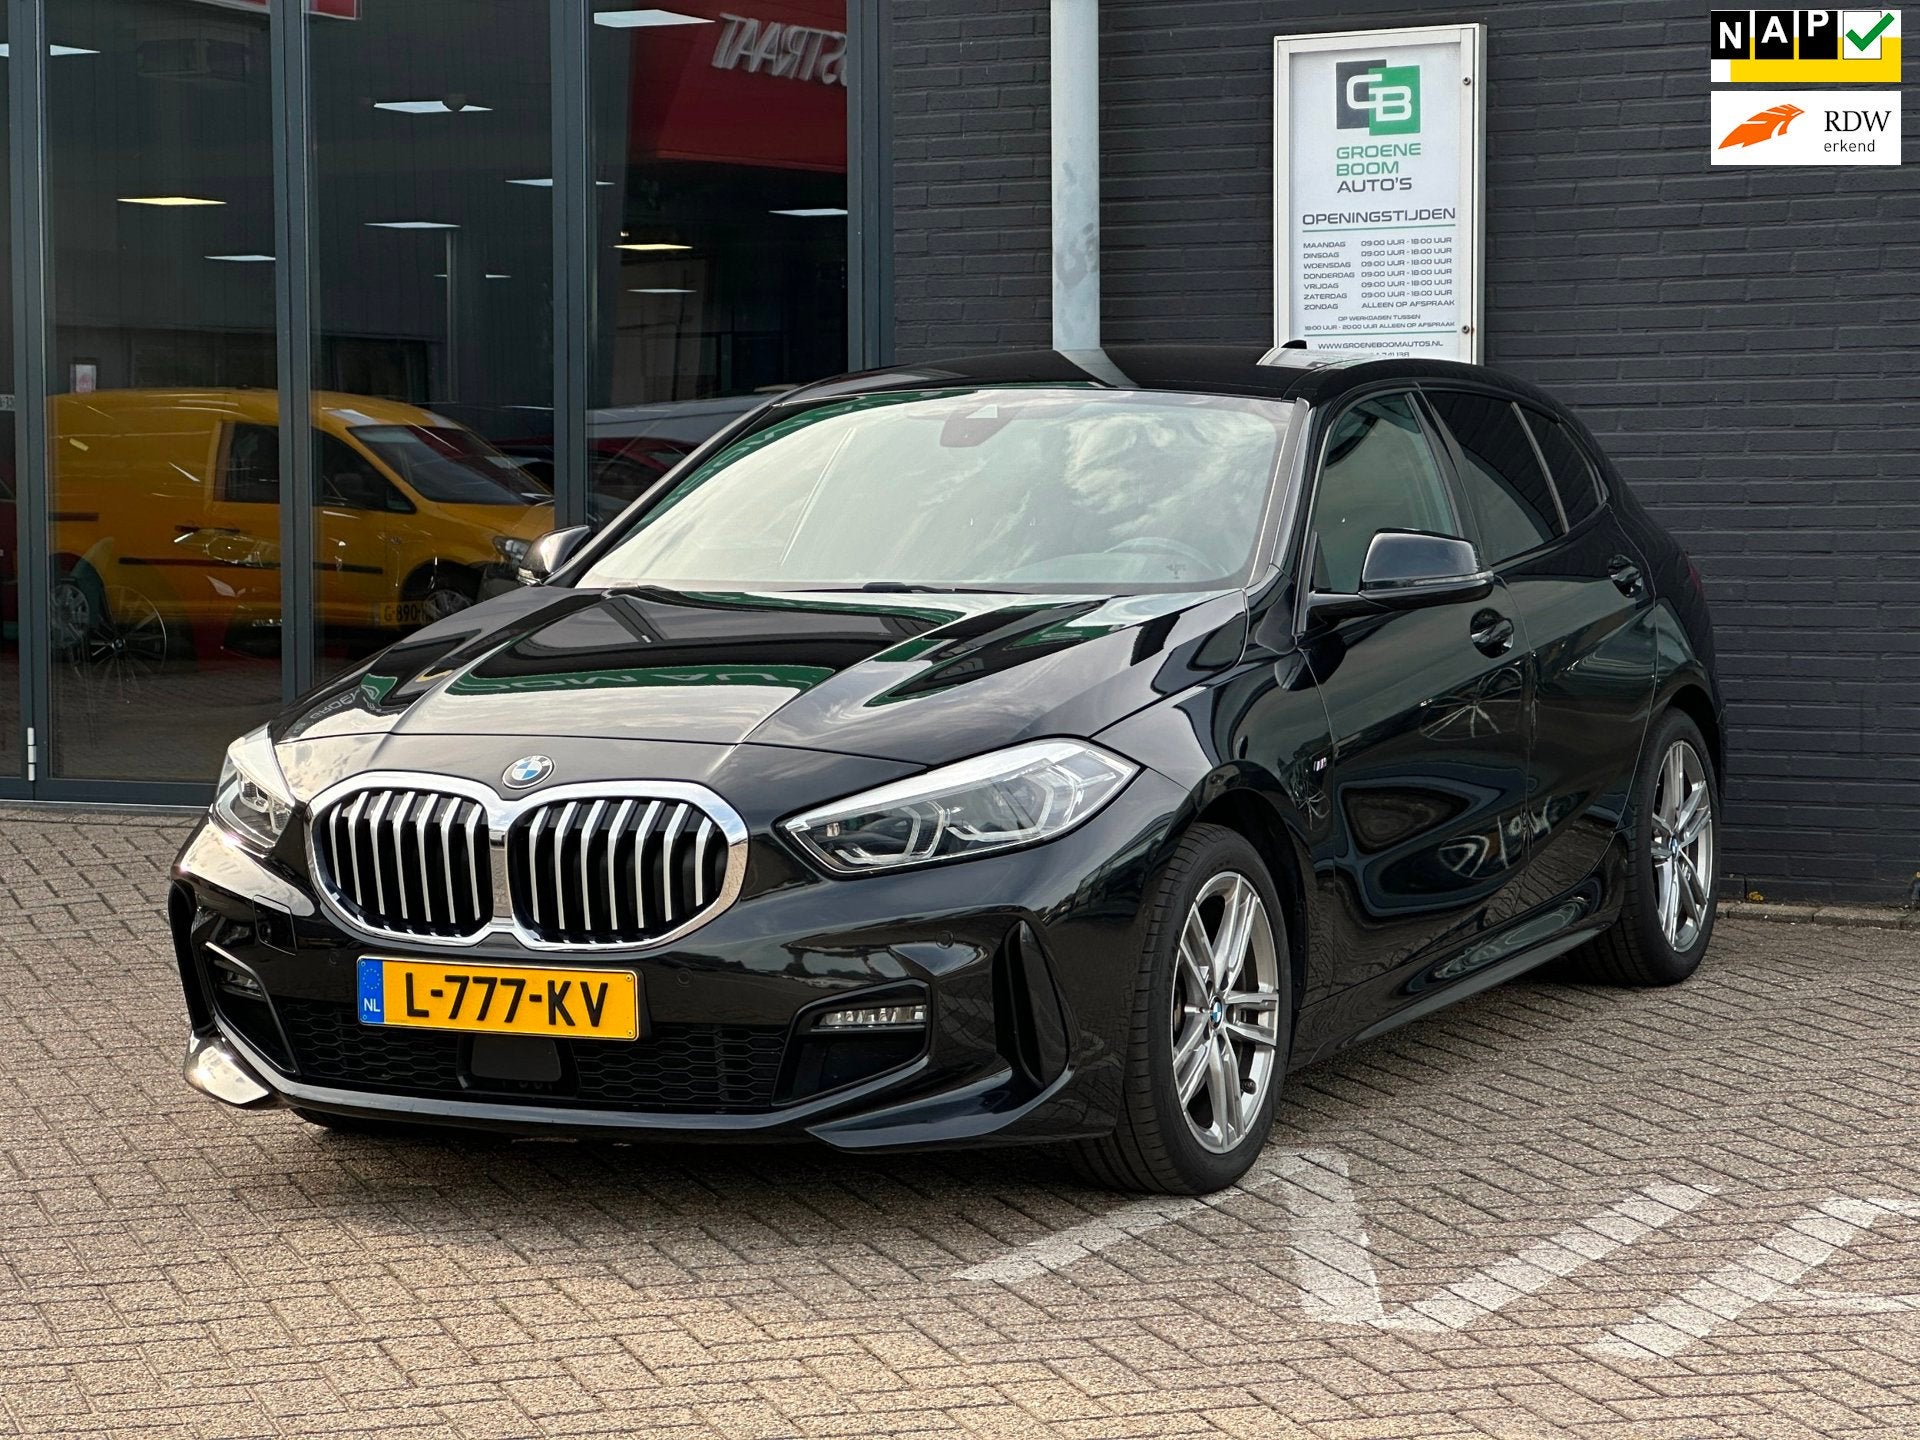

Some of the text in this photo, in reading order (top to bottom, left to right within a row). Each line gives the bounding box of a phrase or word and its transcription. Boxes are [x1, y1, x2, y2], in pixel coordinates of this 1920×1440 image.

[1336, 143, 1421, 160] GROENE
[1336, 161, 1399, 176] BOOM
[1337, 177, 1412, 193] AUTO'S
[1302, 208, 1456, 225] OPENINGSTIJDEN
[1318, 340, 1443, 349] WWW.GROENEBOOMAUTOS.NL
[363, 997, 381, 1013] NL
[405, 972, 609, 1028] L-777-KV
